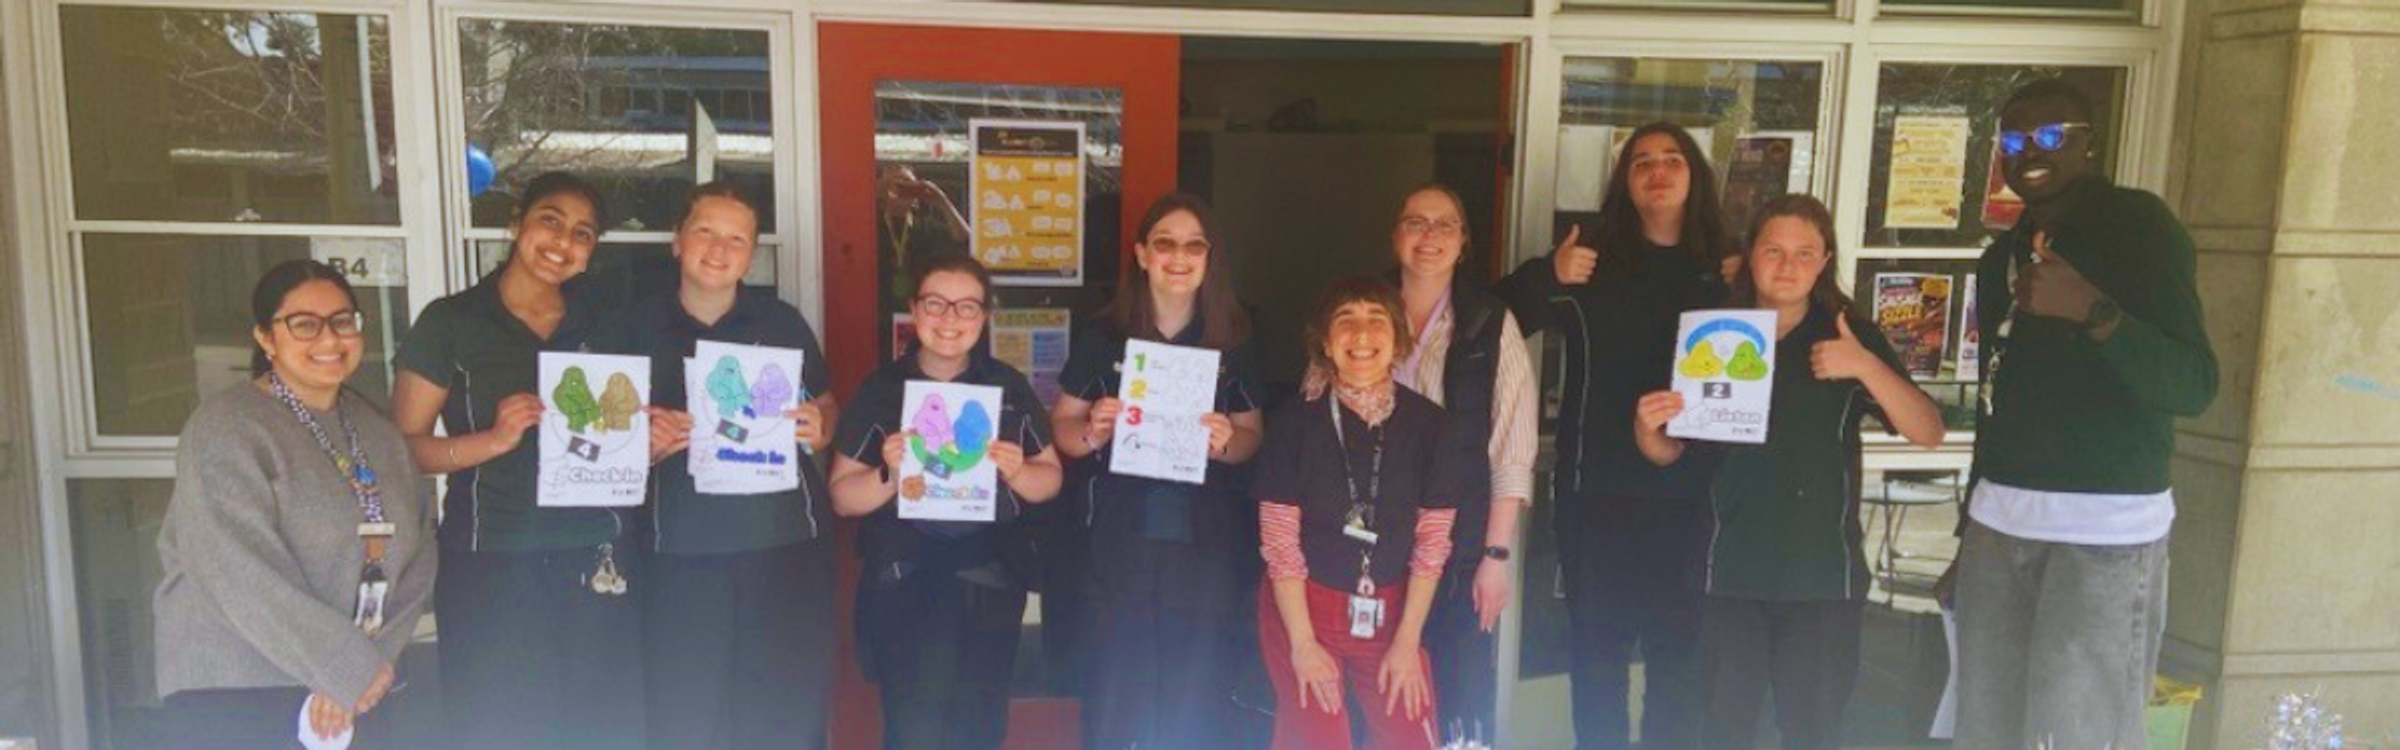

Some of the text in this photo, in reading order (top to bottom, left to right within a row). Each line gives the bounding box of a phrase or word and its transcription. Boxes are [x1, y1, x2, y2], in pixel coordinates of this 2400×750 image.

[1134, 353, 1145, 373] 1
[1129, 379, 1147, 399] 2
[1712, 384, 1725, 398] 2
[1126, 405, 1144, 426] 3
[577, 443, 591, 459] 4
